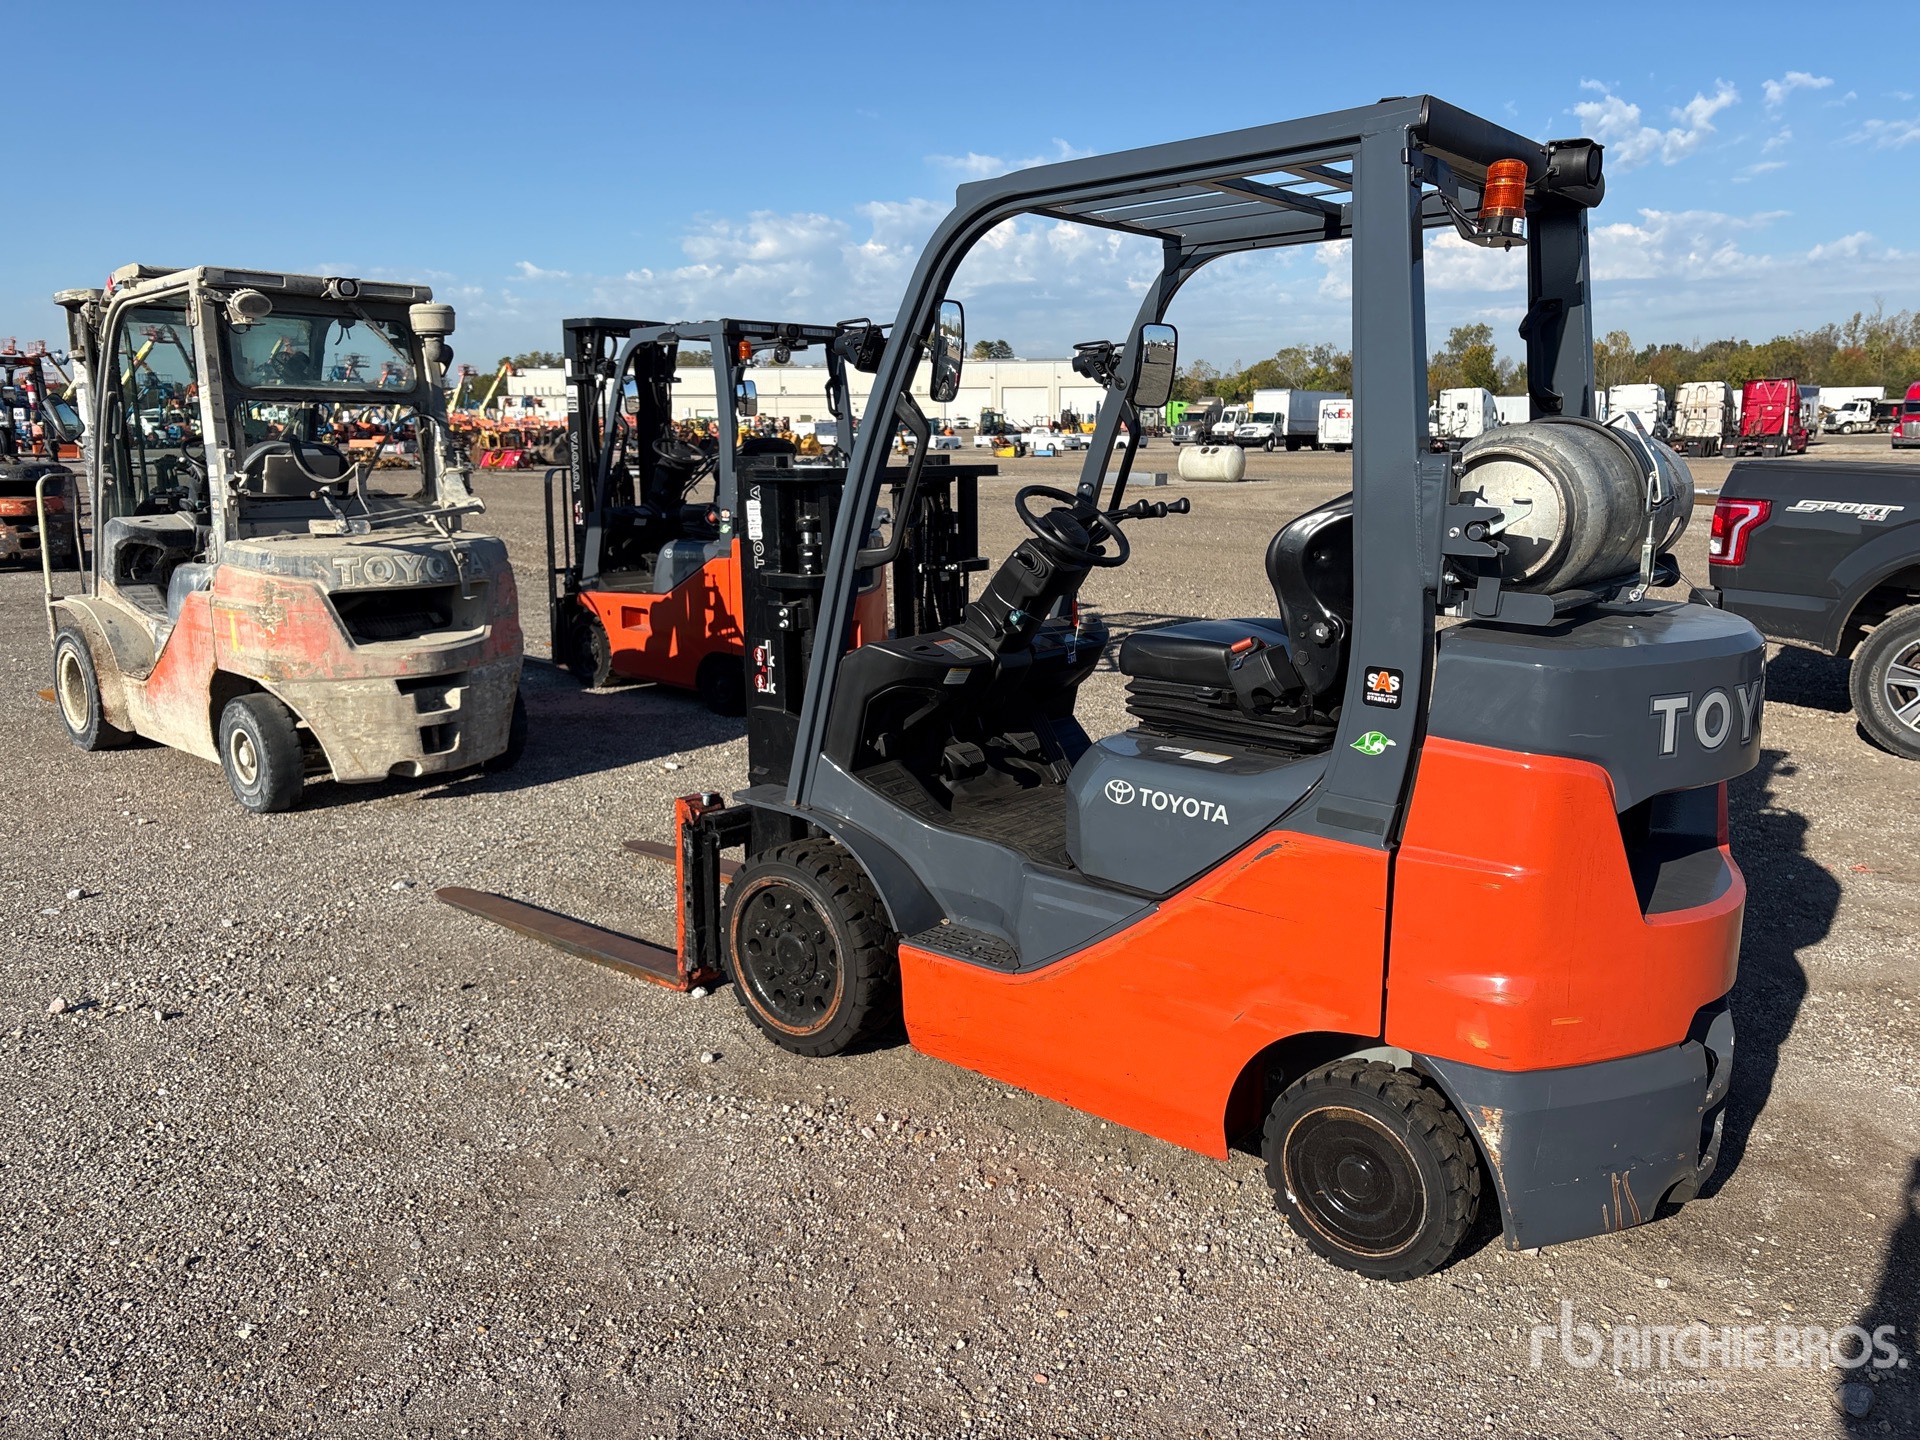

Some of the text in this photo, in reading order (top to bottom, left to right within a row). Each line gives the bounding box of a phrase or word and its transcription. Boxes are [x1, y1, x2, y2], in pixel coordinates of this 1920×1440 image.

[1322, 408, 1352, 419] FedEx
[570, 431, 581, 492] TOYOTA
[1785, 499, 1905, 517] SPORT
[750, 485, 766, 569] TOA
[332, 554, 486, 587] TOYOA
[1367, 671, 1400, 693] SAS
[1367, 695, 1397, 704] STABILITY
[1870, 664, 1902, 735] MICHELIN
[1649, 680, 1761, 759] TOY
[1139, 787, 1229, 825] TOYOTA
